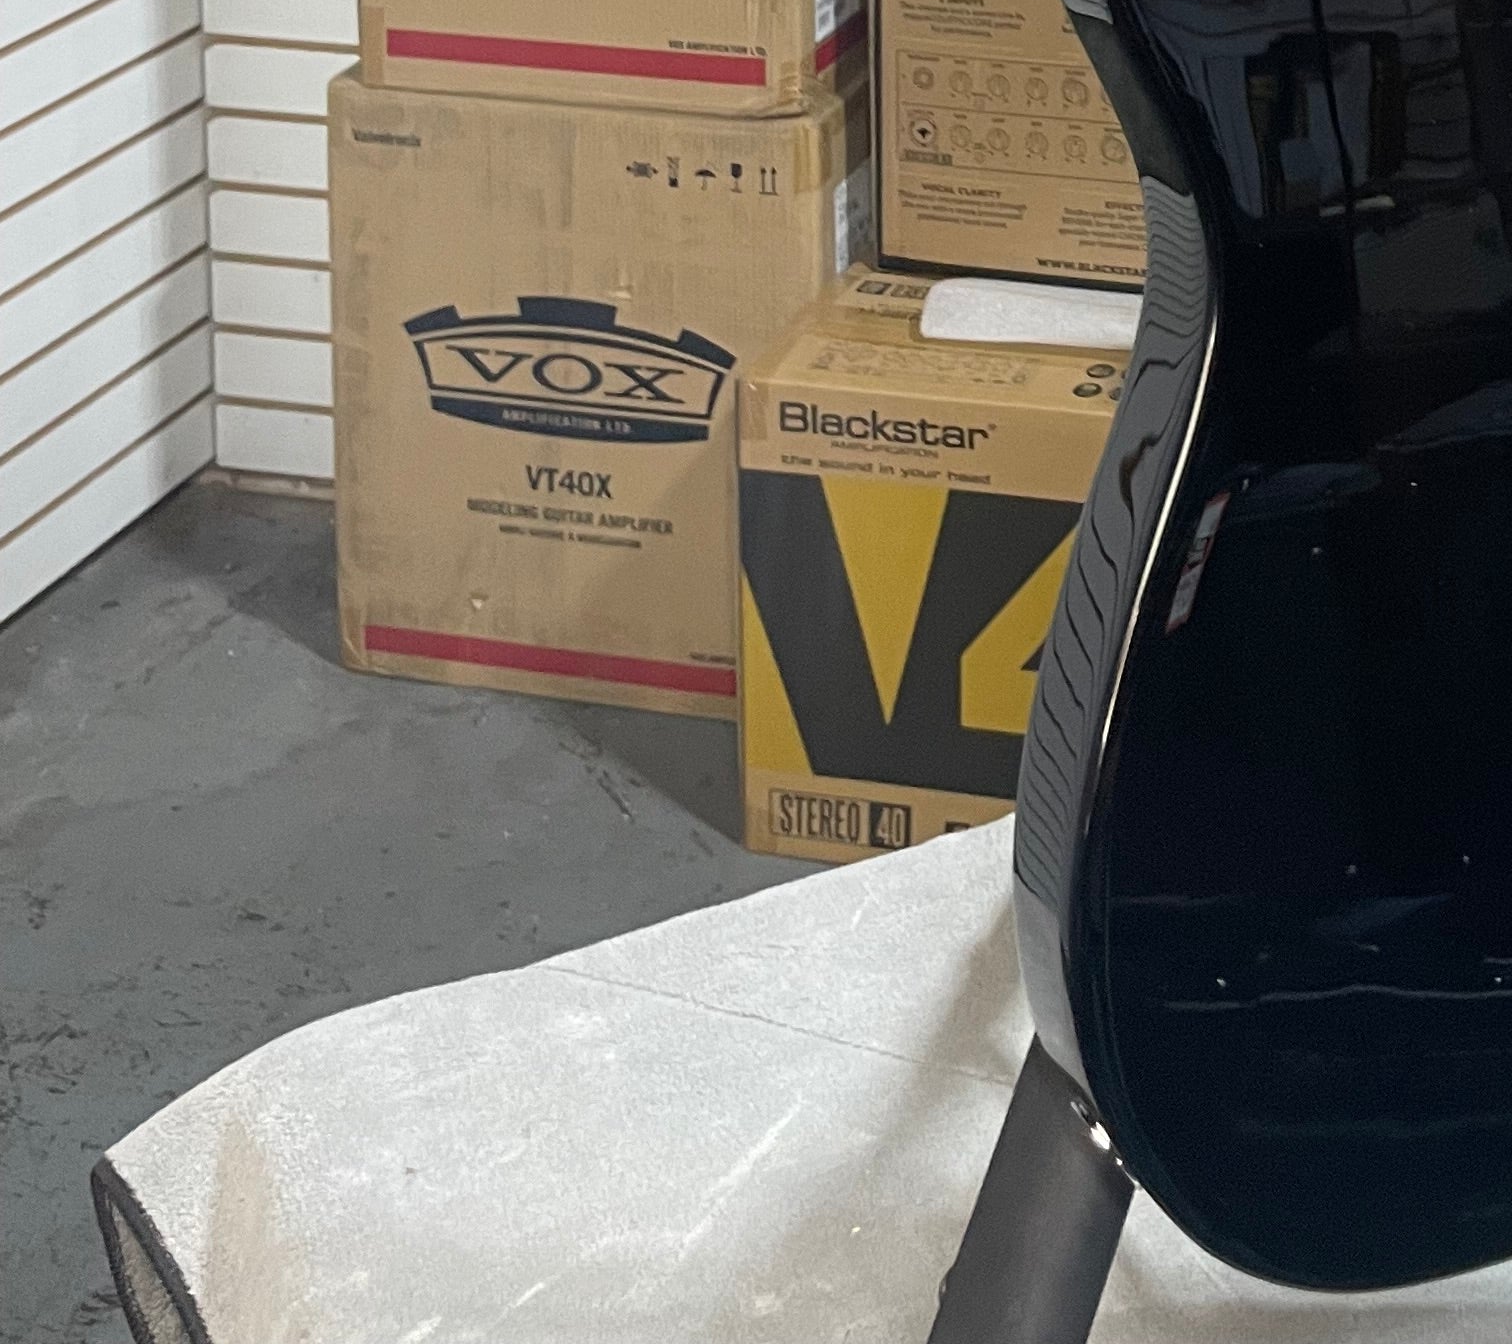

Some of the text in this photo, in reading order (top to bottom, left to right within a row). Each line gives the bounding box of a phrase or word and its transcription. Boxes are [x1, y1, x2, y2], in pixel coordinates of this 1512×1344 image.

[445, 344, 686, 405] VOX
[779, 400, 990, 450] Blackstar
[525, 464, 614, 501] VT40X
[900, 466, 942, 479] your
[599, 512, 674, 536] AMPLIFIER
[779, 793, 906, 846] STEREO 40
